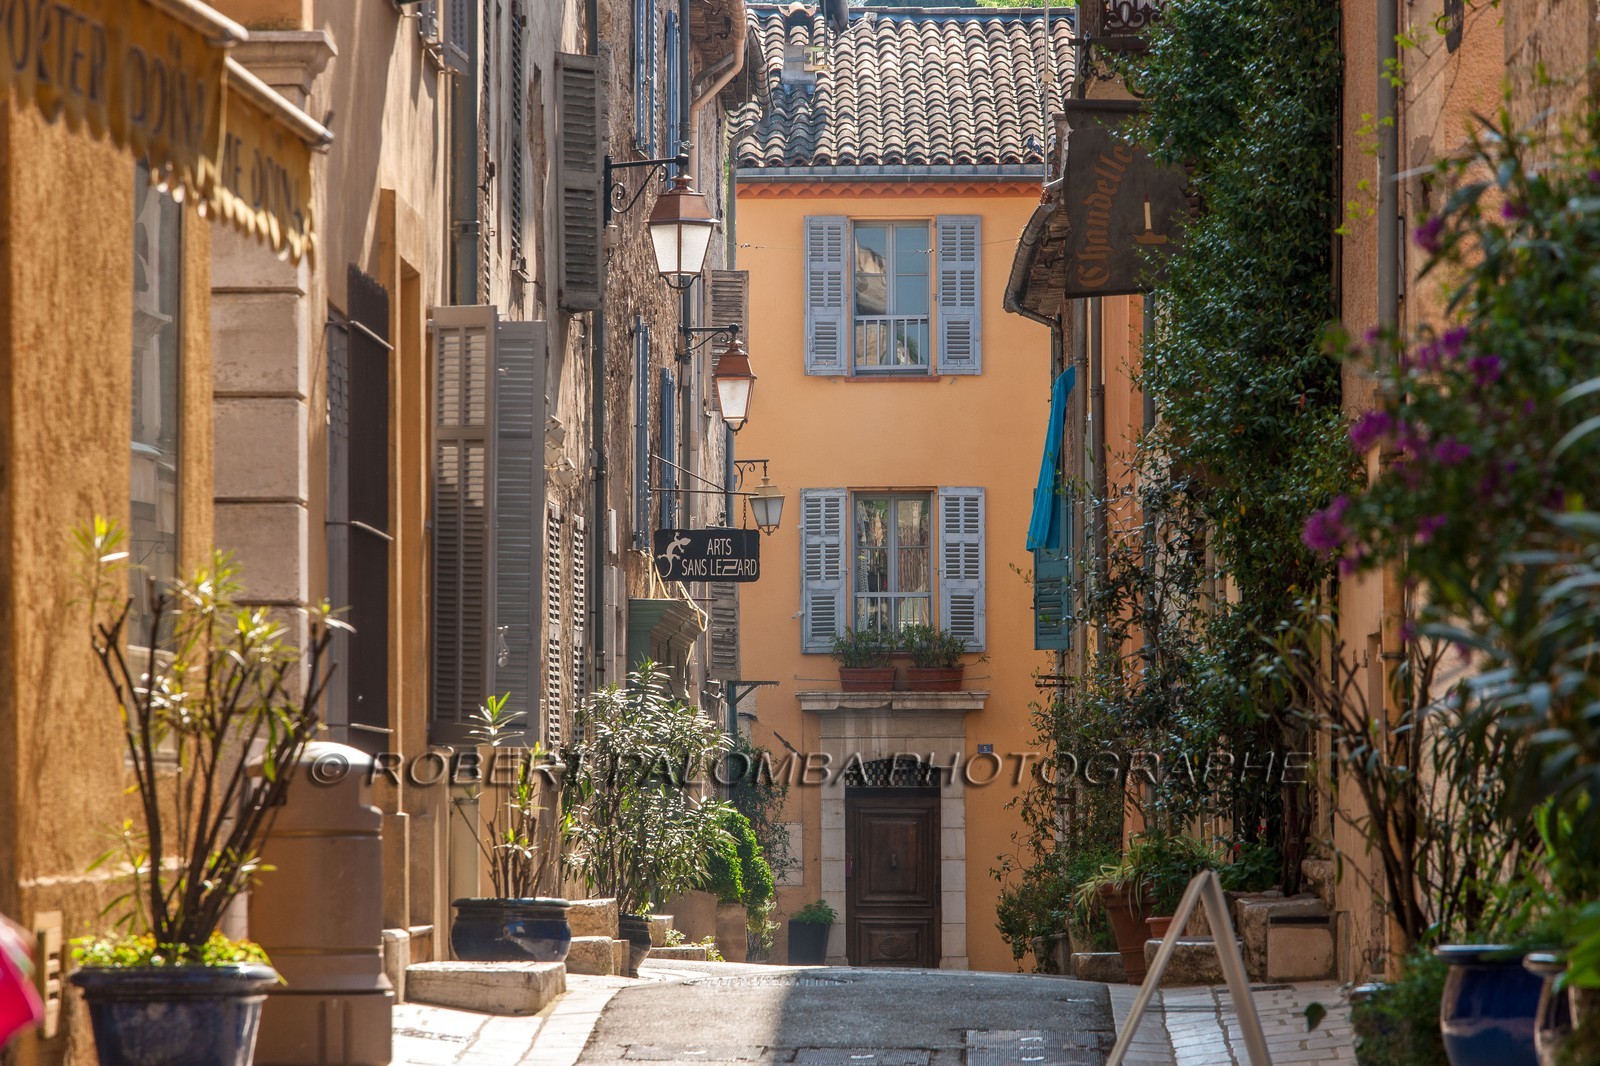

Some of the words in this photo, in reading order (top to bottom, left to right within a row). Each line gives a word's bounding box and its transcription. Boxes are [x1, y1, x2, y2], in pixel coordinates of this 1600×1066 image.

[706, 538, 732, 556] ARTS
[681, 558, 707, 576] SANS
[710, 558, 757, 576] LEZARD
